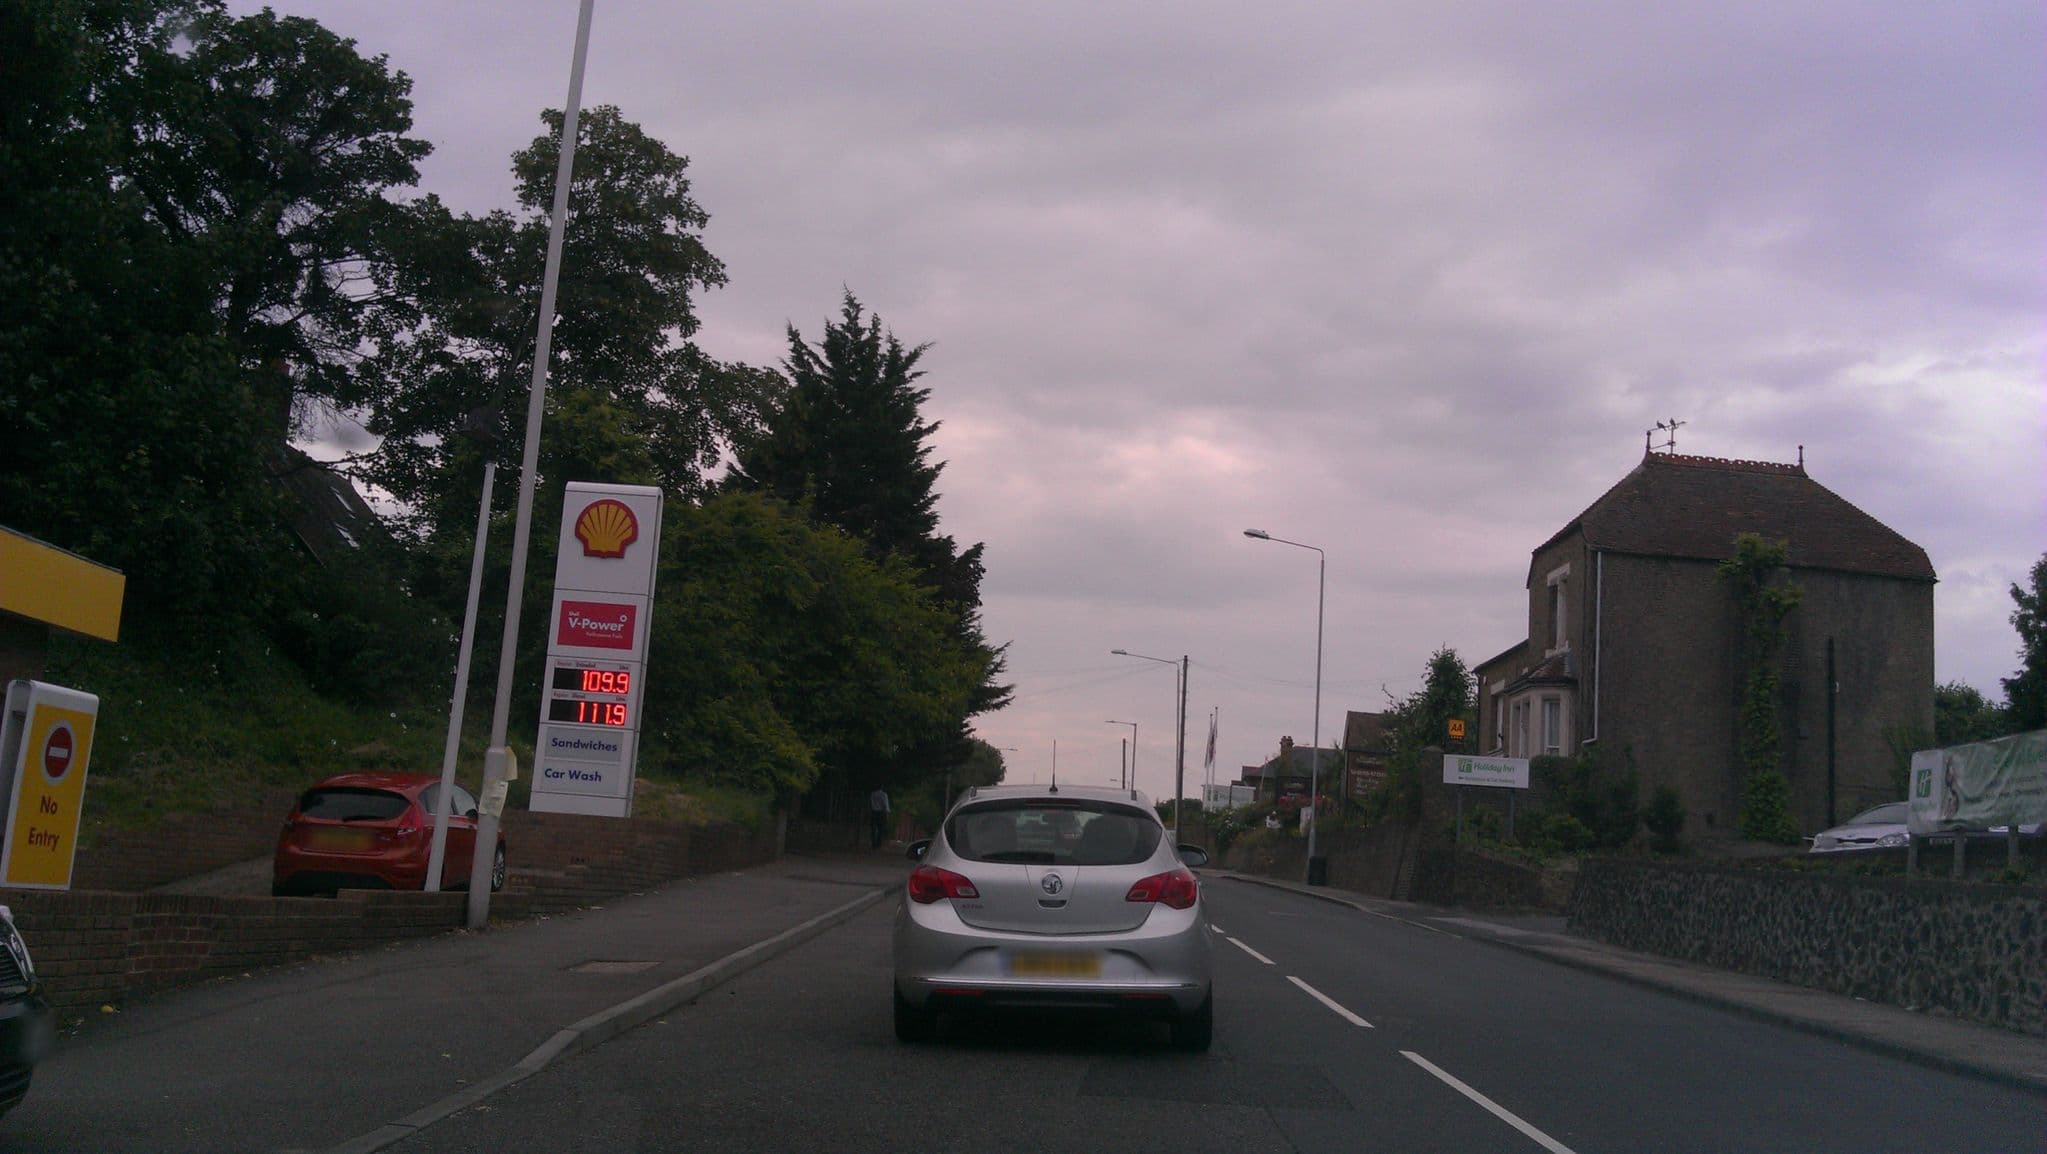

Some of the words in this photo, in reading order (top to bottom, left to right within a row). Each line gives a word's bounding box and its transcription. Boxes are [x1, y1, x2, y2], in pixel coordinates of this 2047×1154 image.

[568, 616, 625, 632] V-Power
[583, 670, 628, 693] 109.9
[579, 701, 626, 725] 111.9
[1450, 723, 1463, 733] AA
[551, 737, 618, 752] Sandwiches
[545, 767, 566, 779] Car
[568, 769, 602, 782] Wash
[40, 795, 58, 815] No
[28, 827, 60, 852] Entry
